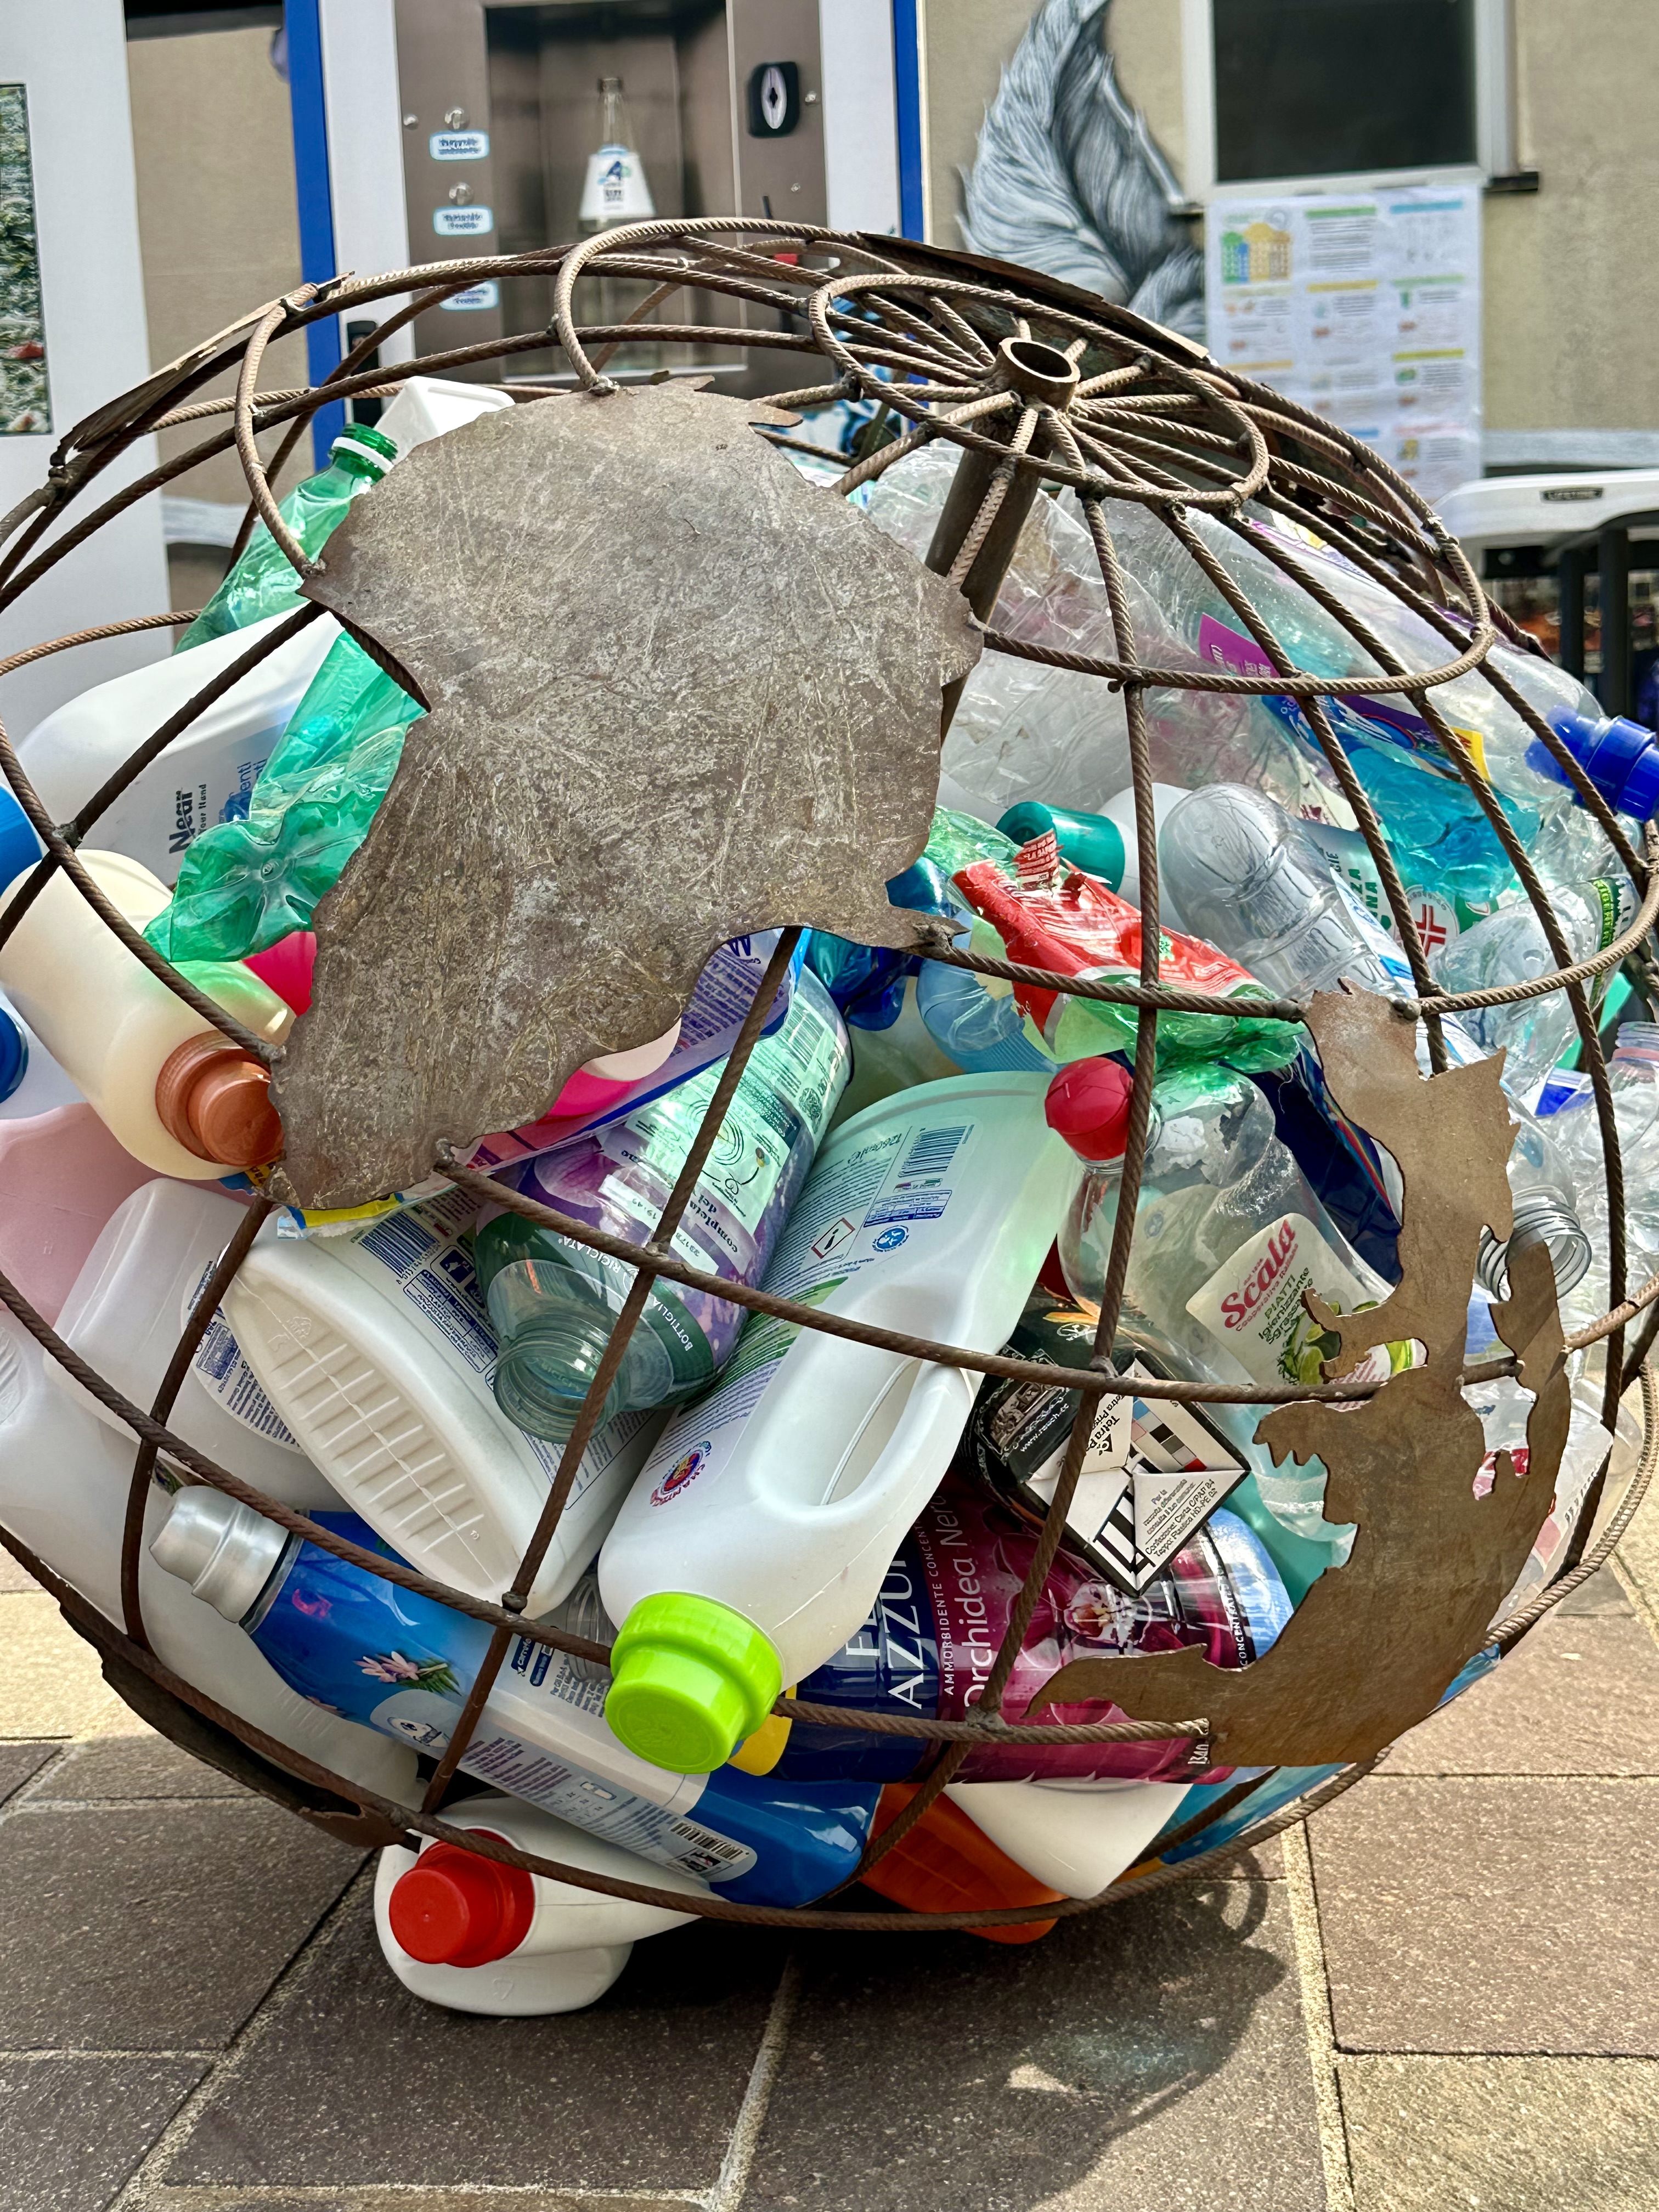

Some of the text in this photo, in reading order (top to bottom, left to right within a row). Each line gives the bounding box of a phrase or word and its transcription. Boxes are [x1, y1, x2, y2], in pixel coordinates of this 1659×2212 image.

[169, 791, 194, 854] Near
[1221, 1220, 1296, 1329] Scala
[1258, 1268, 1310, 1340] Igienizzante
[1265, 1274, 1296, 1319] PIATTI
[651, 1296, 694, 1352] BOTTIGLIA
[1098, 1415, 1120, 1441] Tetra
[932, 1583, 955, 1695] AMMORBIDENTE
